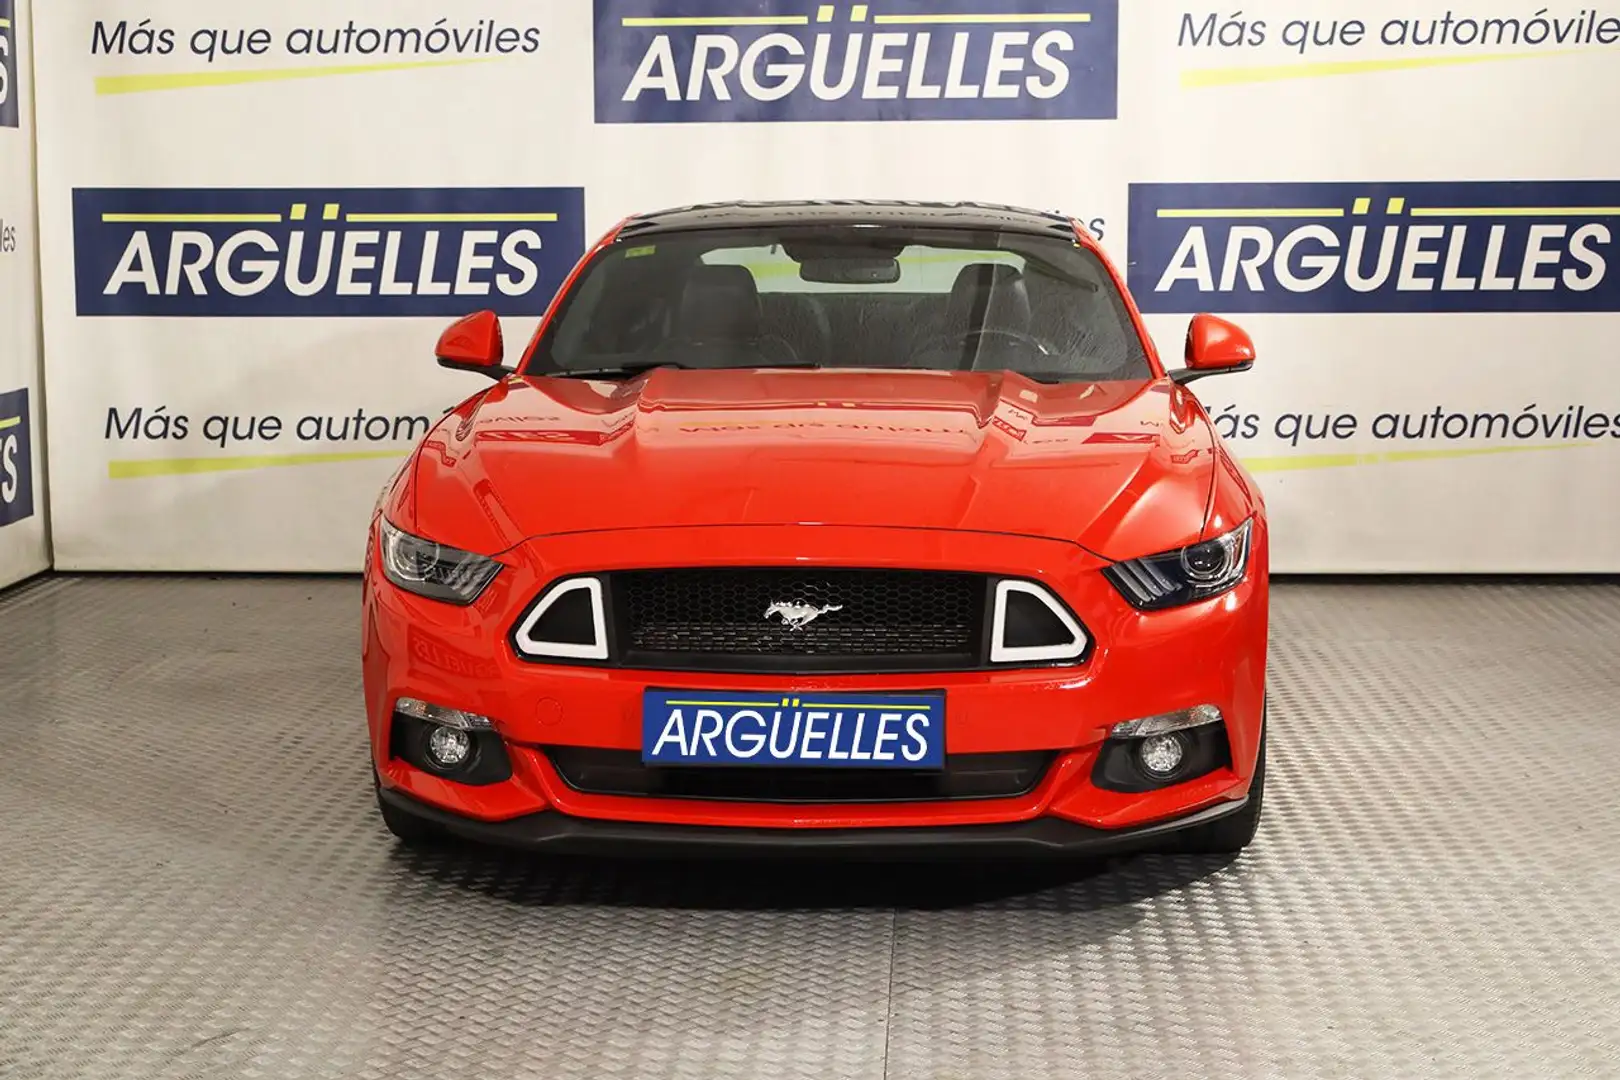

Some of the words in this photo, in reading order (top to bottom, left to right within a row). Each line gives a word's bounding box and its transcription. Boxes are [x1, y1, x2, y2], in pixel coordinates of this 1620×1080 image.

[92, 19, 174, 54] Más
[191, 29, 271, 62] que
[287, 18, 540, 55] automóviles
[621, 5, 1074, 102] ARGÜELLES
[1178, 11, 1265, 46] Más
[1283, 21, 1364, 53] que
[103, 202, 542, 297] ARGÜELLES
[1154, 197, 1610, 293] ARGÜELLES
[105, 405, 188, 440] Más
[203, 416, 282, 448] que
[297, 406, 454, 441] autom
[1204, 404, 1260, 440] ás
[1275, 413, 1357, 446] que
[651, 698, 931, 762] ARGÜELLES
